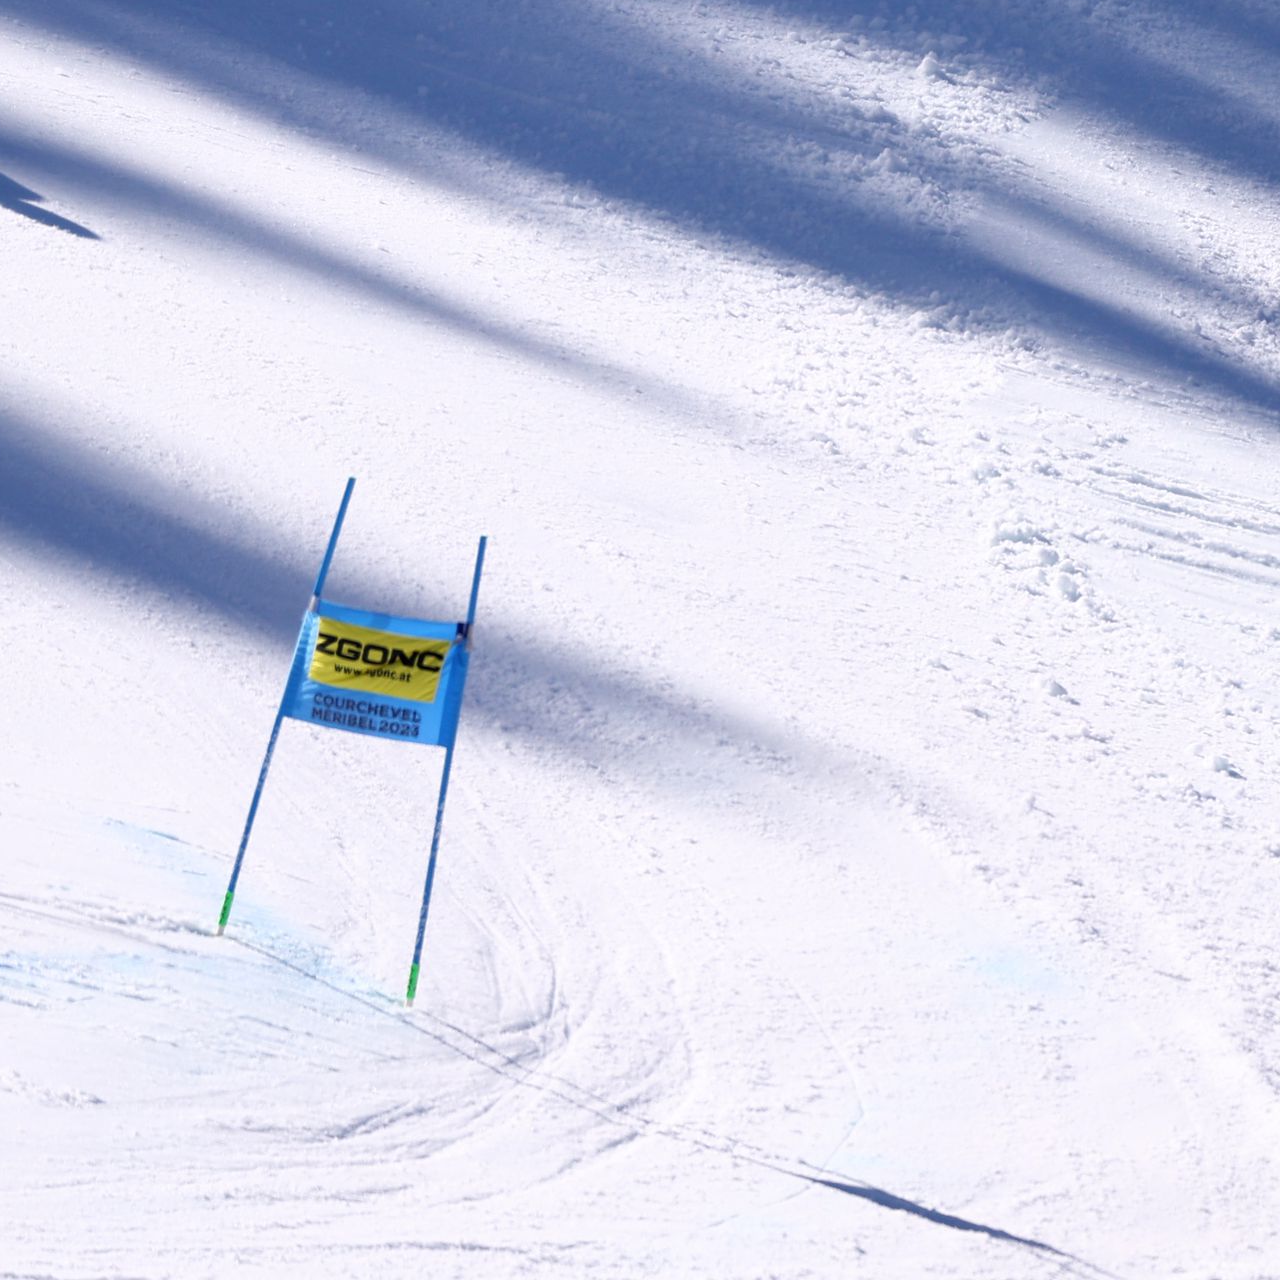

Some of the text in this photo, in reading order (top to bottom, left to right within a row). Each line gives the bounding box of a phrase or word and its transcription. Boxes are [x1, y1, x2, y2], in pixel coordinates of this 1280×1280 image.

[316, 632, 444, 673] ZGONC
[334, 663, 411, 683] www.zgonc.at
[313, 693, 422, 722] COURCHEVEL
